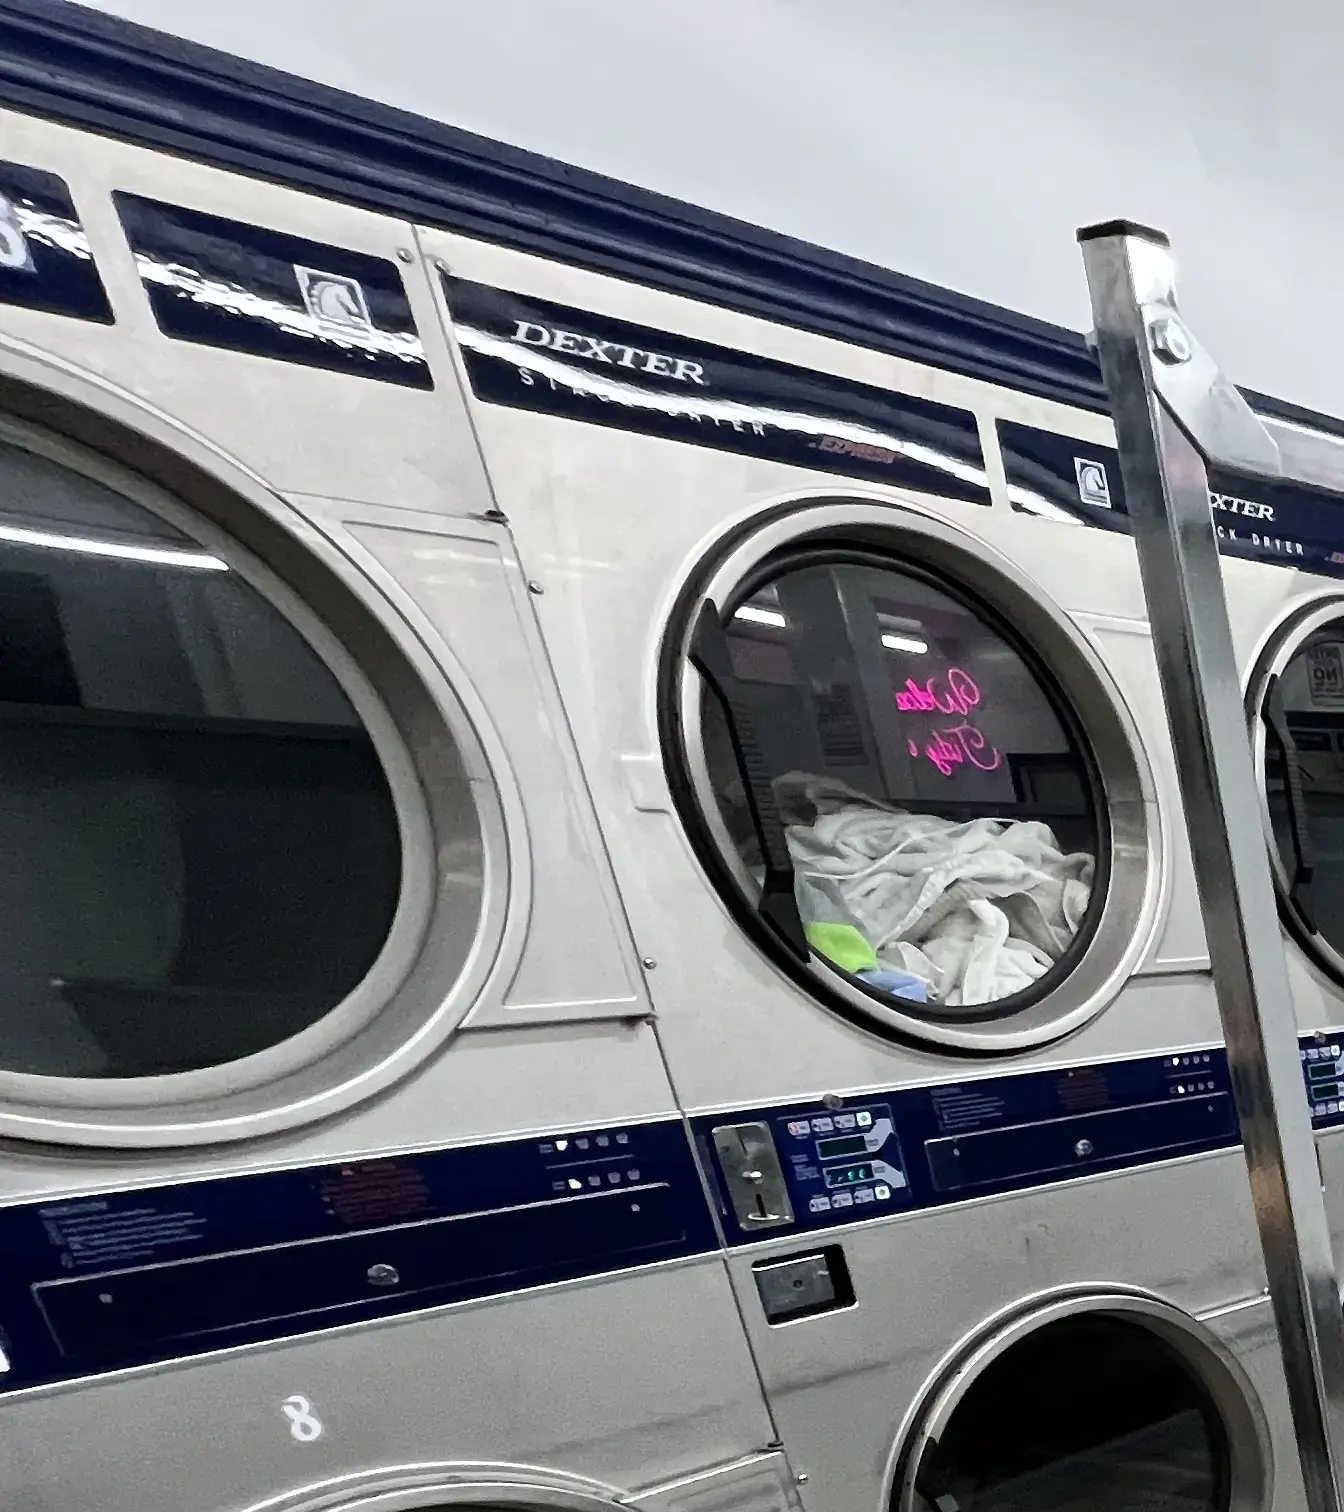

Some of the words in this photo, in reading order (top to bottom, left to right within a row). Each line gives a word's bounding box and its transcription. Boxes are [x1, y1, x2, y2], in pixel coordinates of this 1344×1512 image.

[511, 319, 704, 387] DEXTER
[1211, 492, 1275, 522] XTER
[1251, 532, 1305, 557] DRYER
[282, 1395, 323, 1442] 8
